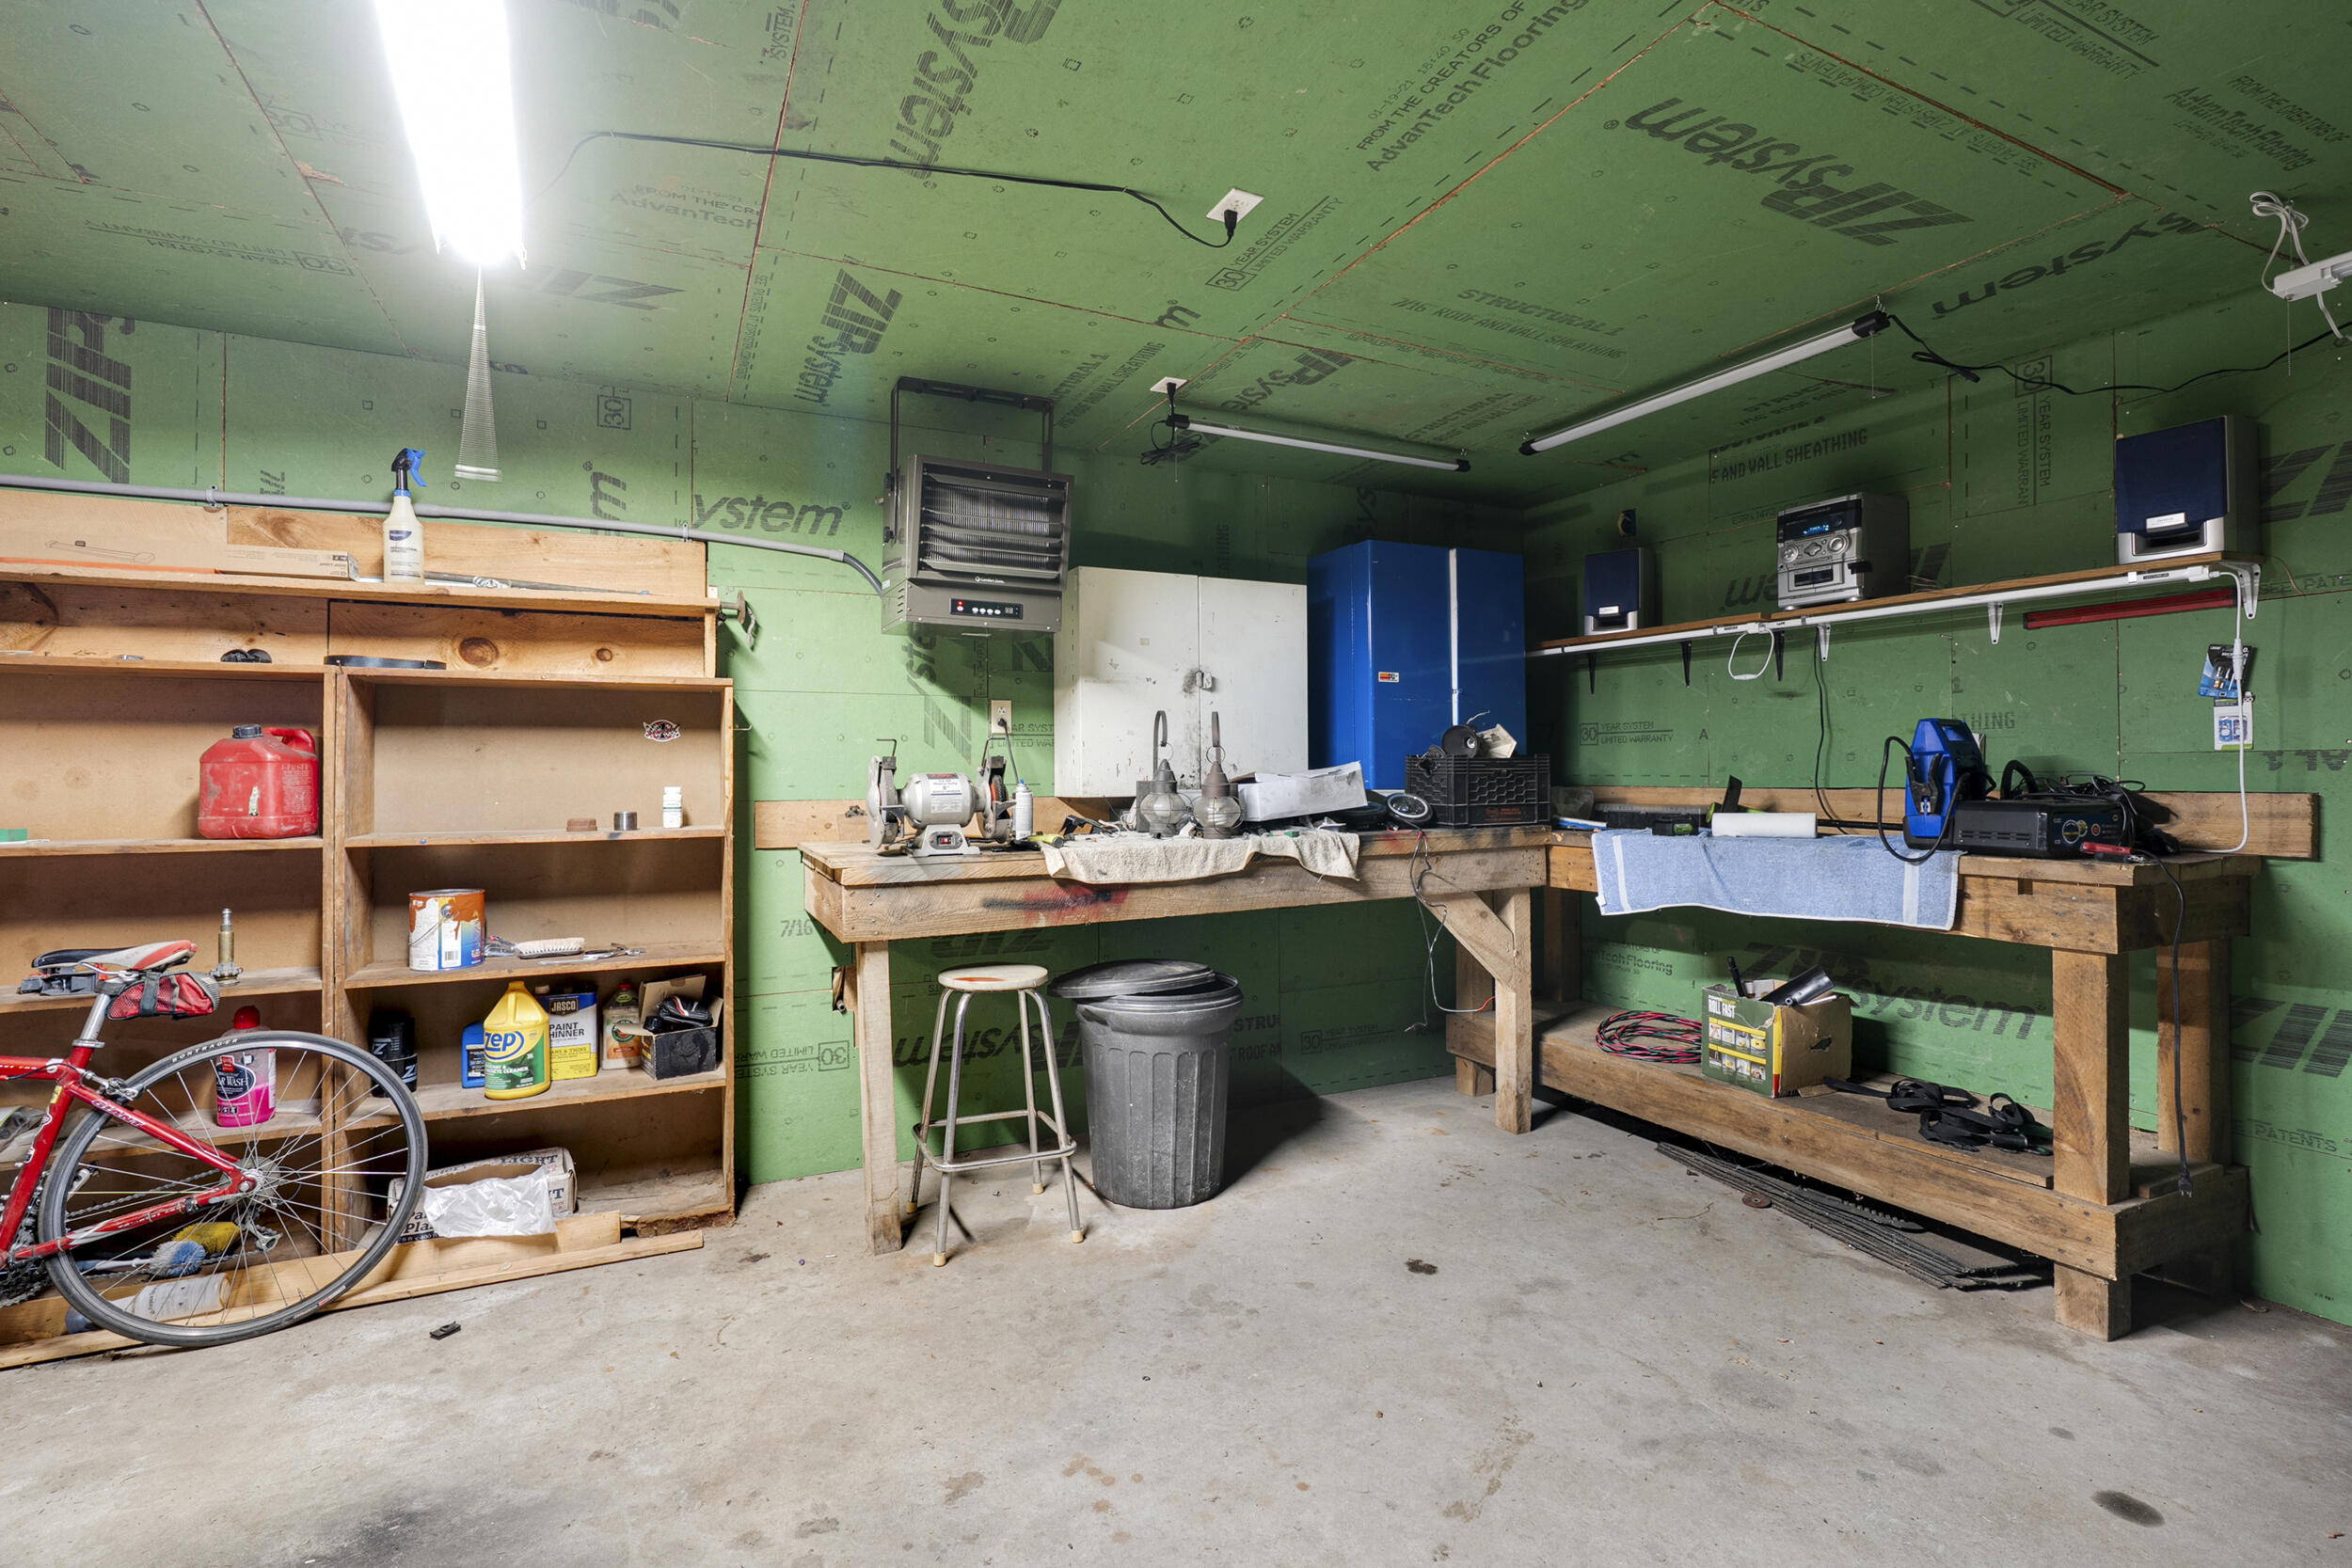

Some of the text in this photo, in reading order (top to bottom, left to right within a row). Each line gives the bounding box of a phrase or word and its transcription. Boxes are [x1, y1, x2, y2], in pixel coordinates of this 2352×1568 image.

[2098, 2, 2160, 46] SYSTEM
[2016, 8, 2146, 80] LIMITED WARRANTY
[1356, 0, 1526, 150] FROM THE CREATORS OF
[1367, 78, 1483, 172] AdvanTech
[693, 196, 728, 210] THE
[1250, 198, 1343, 272] LIMITED WARRANTY
[145, 237, 233, 260] SYSTEM
[240, 252, 294, 267] YEAR
[1215, 213, 1301, 288] 30 YEAR SYSTEM
[1457, 288, 1610, 333] STRUCTURAL
[1432, 306, 1476, 324] ROOF
[1473, 314, 1507, 332] AND
[1505, 322, 1546, 341] WALL
[1545, 333, 1628, 360] SHEATHING
[1113, 341, 1167, 379] SHEATHING
[602, 398, 626, 426] 30
[2023, 361, 2052, 487] 30 YEAR SYSTEM
[1721, 461, 1746, 483] AND
[1746, 451, 1783, 475] WALL
[1784, 427, 1867, 466] SHEATHING
[2016, 401, 2029, 505] LIMITED WARRAN
[693, 493, 838, 537] ystem
[1027, 723, 1055, 734] SYST
[1581, 721, 1655, 742] 30 YEAR SYSTEM
[1600, 734, 1675, 744] LIMITED WARRANTY
[780, 918, 814, 938] 7/16
[1625, 954, 1674, 976] Flooring
[551, 1000, 577, 1012] JASCO
[1708, 997, 1722, 1015] ROLL
[1722, 1002, 1737, 1020] FAST
[548, 1028, 585, 1038] HINNER
[549, 1022, 580, 1032] PAINT
[172, 1037, 238, 1064] BONTRAGER
[1237, 1044, 1267, 1062] ROOF
[1302, 1035, 1322, 1051] 30
[770, 1045, 814, 1060] LIMITED
[820, 1046, 848, 1066] 30
[227, 1075, 248, 1086] WASH
[734, 1062, 814, 1081] SYSTE YEAR
[91, 1099, 144, 1128] GIANT
[499, 1153, 559, 1165] LIGHT
